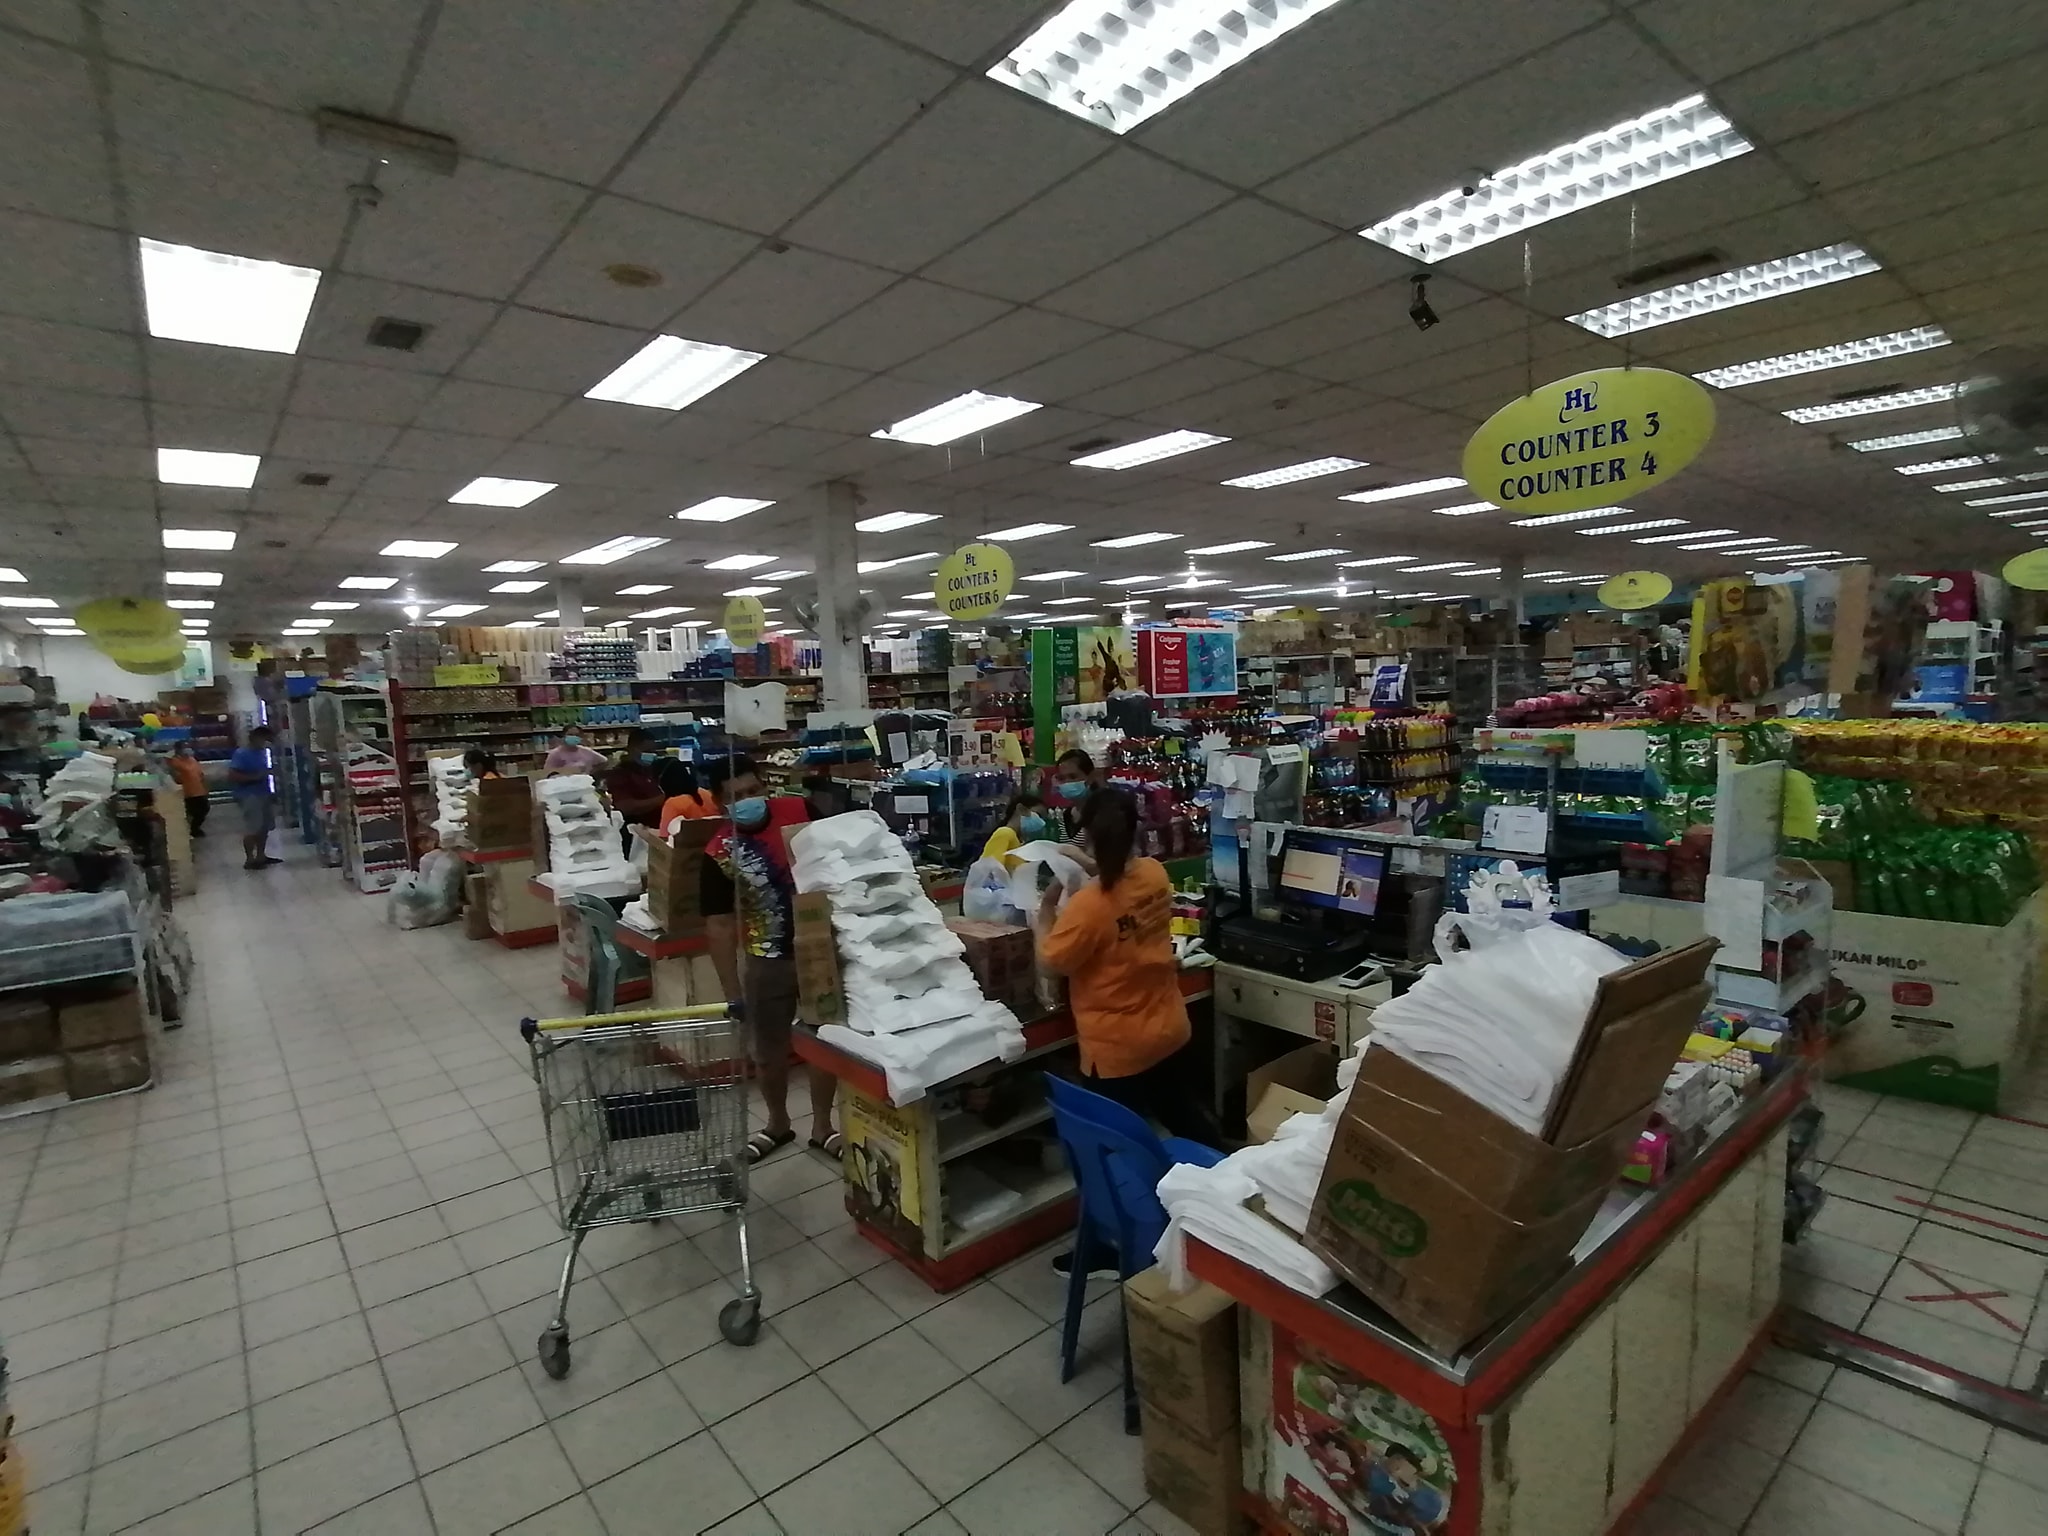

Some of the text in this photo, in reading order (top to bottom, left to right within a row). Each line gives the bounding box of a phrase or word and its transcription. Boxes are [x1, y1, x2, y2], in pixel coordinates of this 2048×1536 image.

[1564, 387, 1598, 413] HL
[1500, 411, 1661, 466] COUNTER 3
[1499, 450, 1658, 501] COUNTER 4
[948, 569, 998, 592] COUNTER 5
[949, 589, 999, 612] COUNTER 6
[1159, 635, 1182, 645] Colgate
